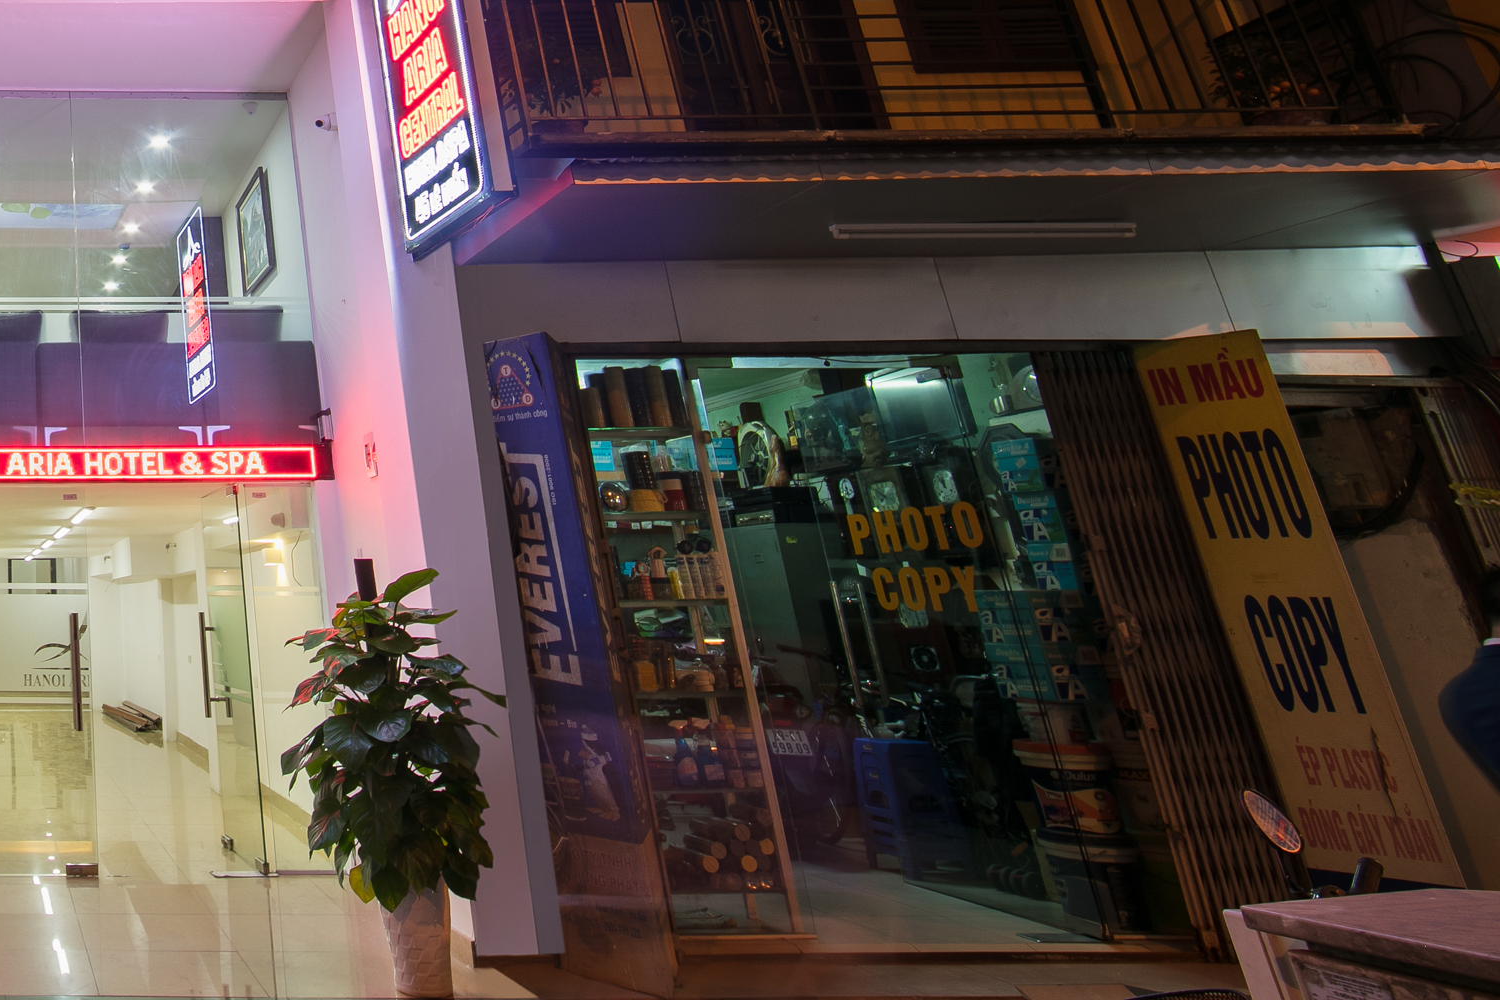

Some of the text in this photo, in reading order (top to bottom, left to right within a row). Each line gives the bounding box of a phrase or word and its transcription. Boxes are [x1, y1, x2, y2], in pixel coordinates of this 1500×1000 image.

[402, 27, 449, 107] ARIA
[399, 71, 466, 159] CENTRAL
[1147, 367, 1188, 406] IN
[7, 451, 74, 476] ARIA
[84, 451, 174, 476] HOTEL
[179, 451, 204, 476] &
[211, 451, 266, 476] SPA
[1176, 427, 1312, 540] PHOTO
[846, 501, 984, 556] PHOTO
[499, 442, 583, 686] EVEREST
[872, 565, 979, 613] COPY
[23, 674, 66, 687] HANOI
[1244, 594, 1367, 715] COPY
[1063, 770, 1097, 781] Dulux
[1295, 736, 1399, 794] ÉP PLASTIC
[1297, 799, 1352, 853] ĐÓNG
[1346, 803, 1388, 857] GÁY
[600, 852, 633, 870] TNHH
